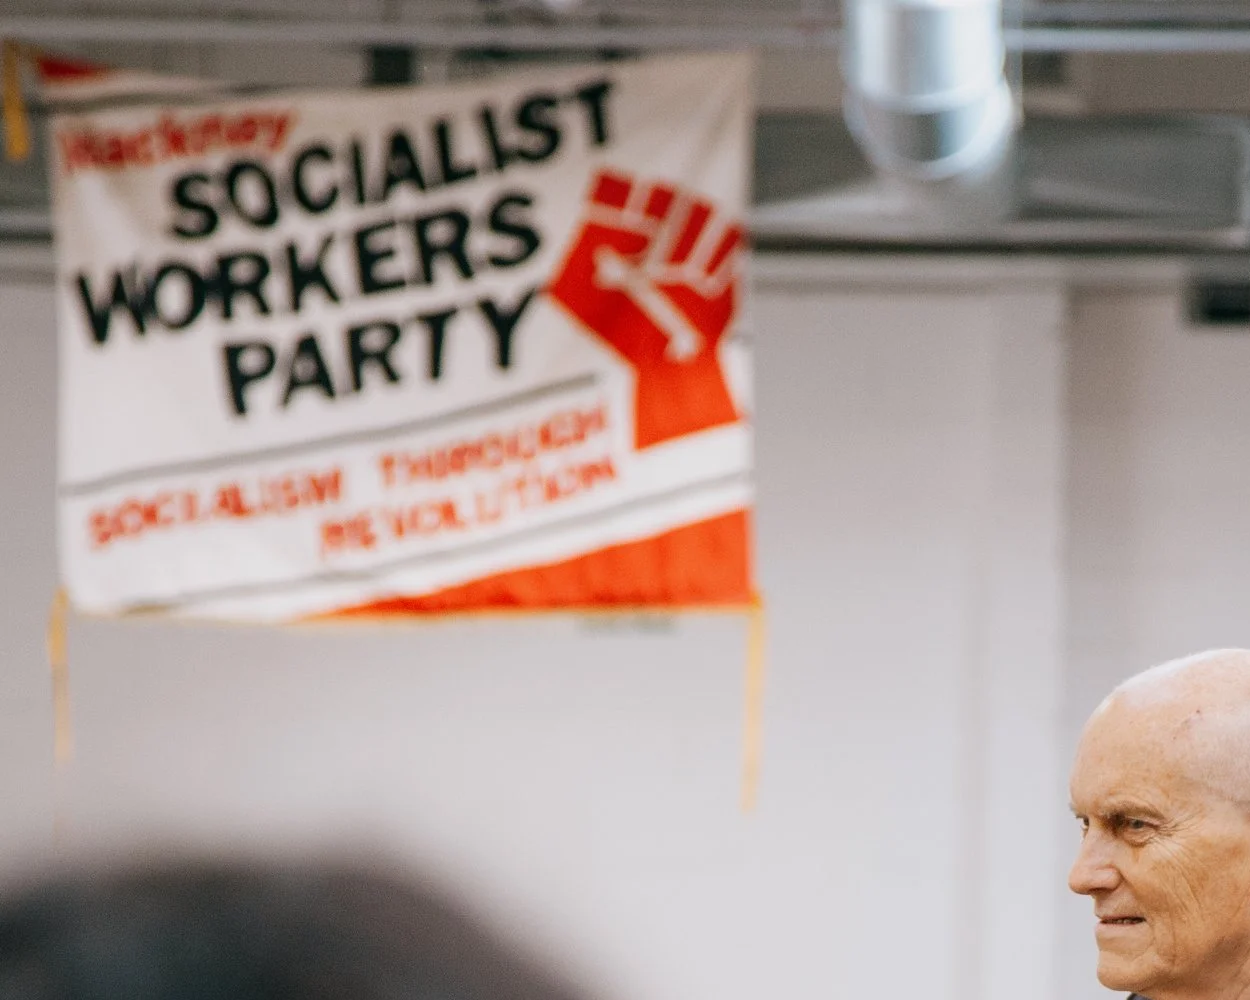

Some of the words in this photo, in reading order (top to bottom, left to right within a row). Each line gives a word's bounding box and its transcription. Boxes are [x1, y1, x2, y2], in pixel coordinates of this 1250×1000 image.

[170, 79, 615, 241] SOCIALIST
[76, 193, 541, 346] WORKERS
[223, 290, 536, 416] PARTY
[88, 466, 344, 549] SOCIALISM
[379, 404, 609, 488] THROUGH
[320, 459, 617, 555] REVOLUTION
